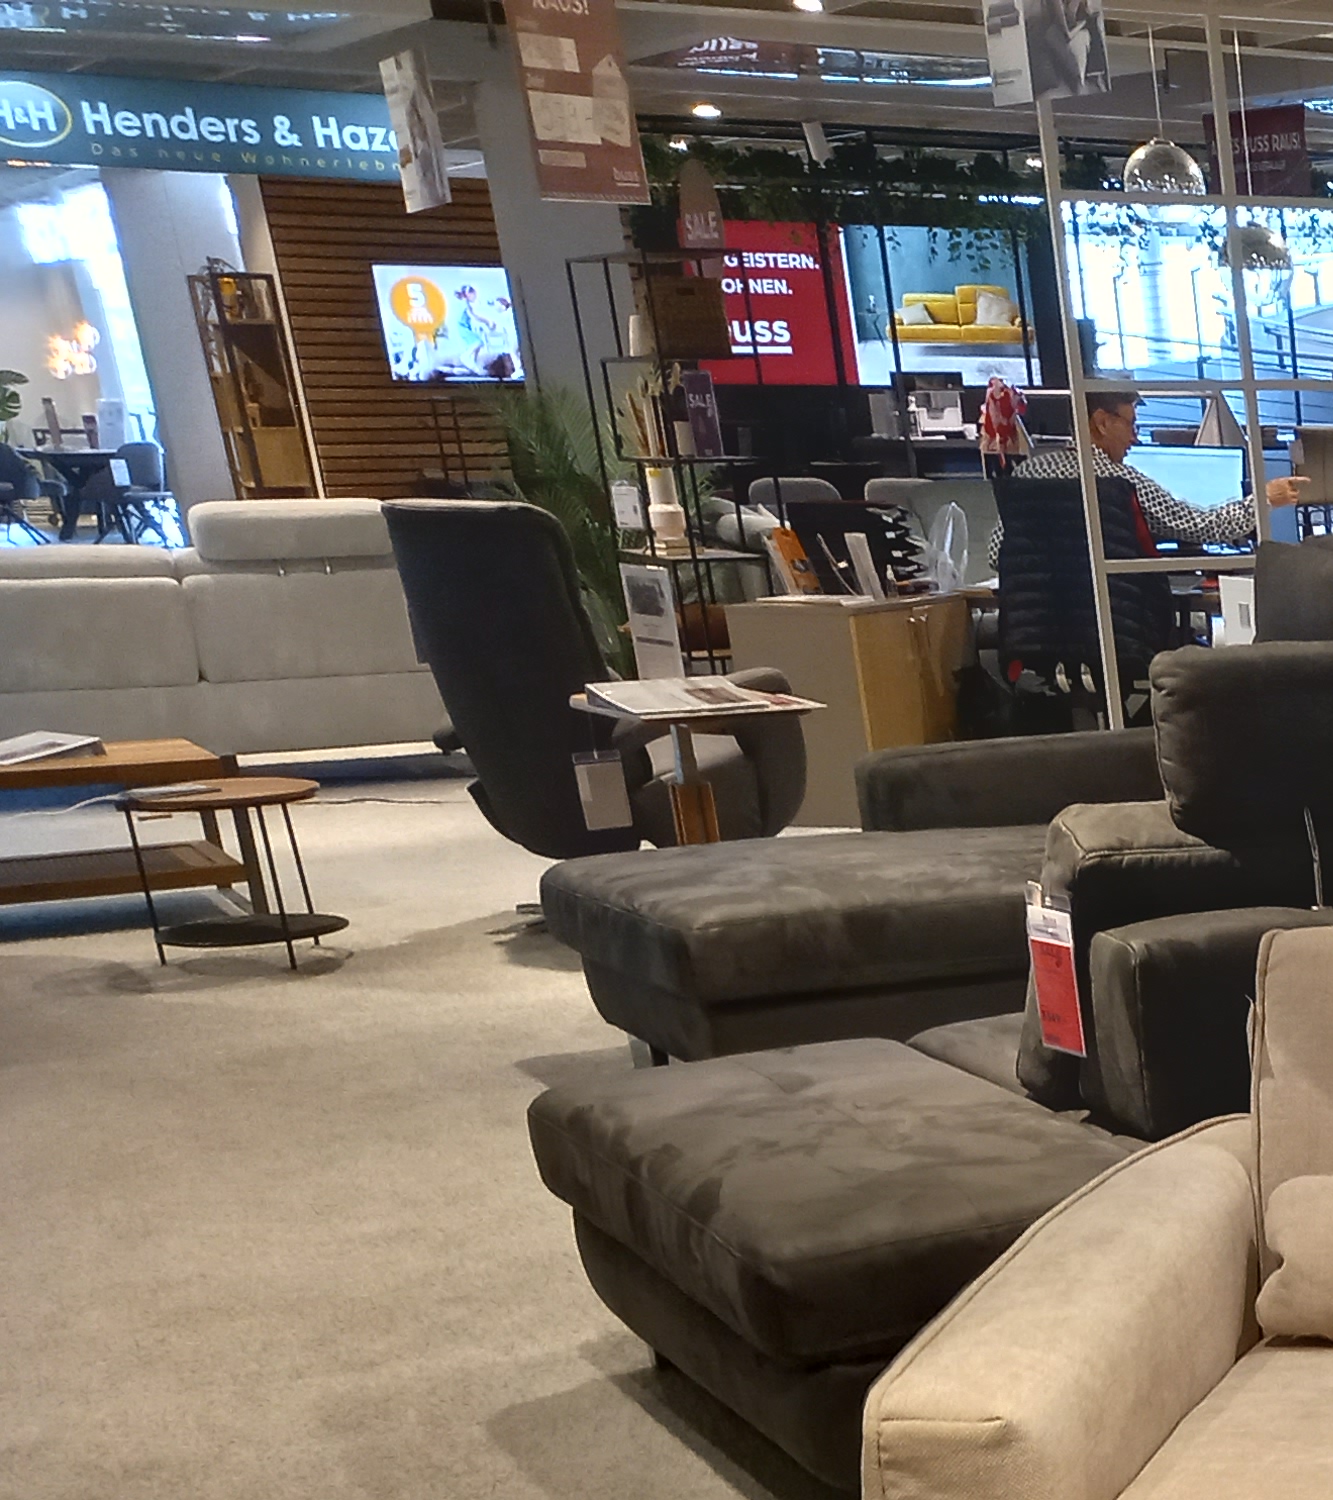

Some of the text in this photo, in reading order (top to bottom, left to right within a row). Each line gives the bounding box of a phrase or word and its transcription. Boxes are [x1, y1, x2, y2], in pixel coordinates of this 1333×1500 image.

[80, 100, 261, 144] Henders
[273, 115, 303, 147] &
[91, 142, 138, 157] Das
[158, 150, 221, 162] neue
[685, 211, 719, 240] SALE
[728, 320, 791, 343] uss
